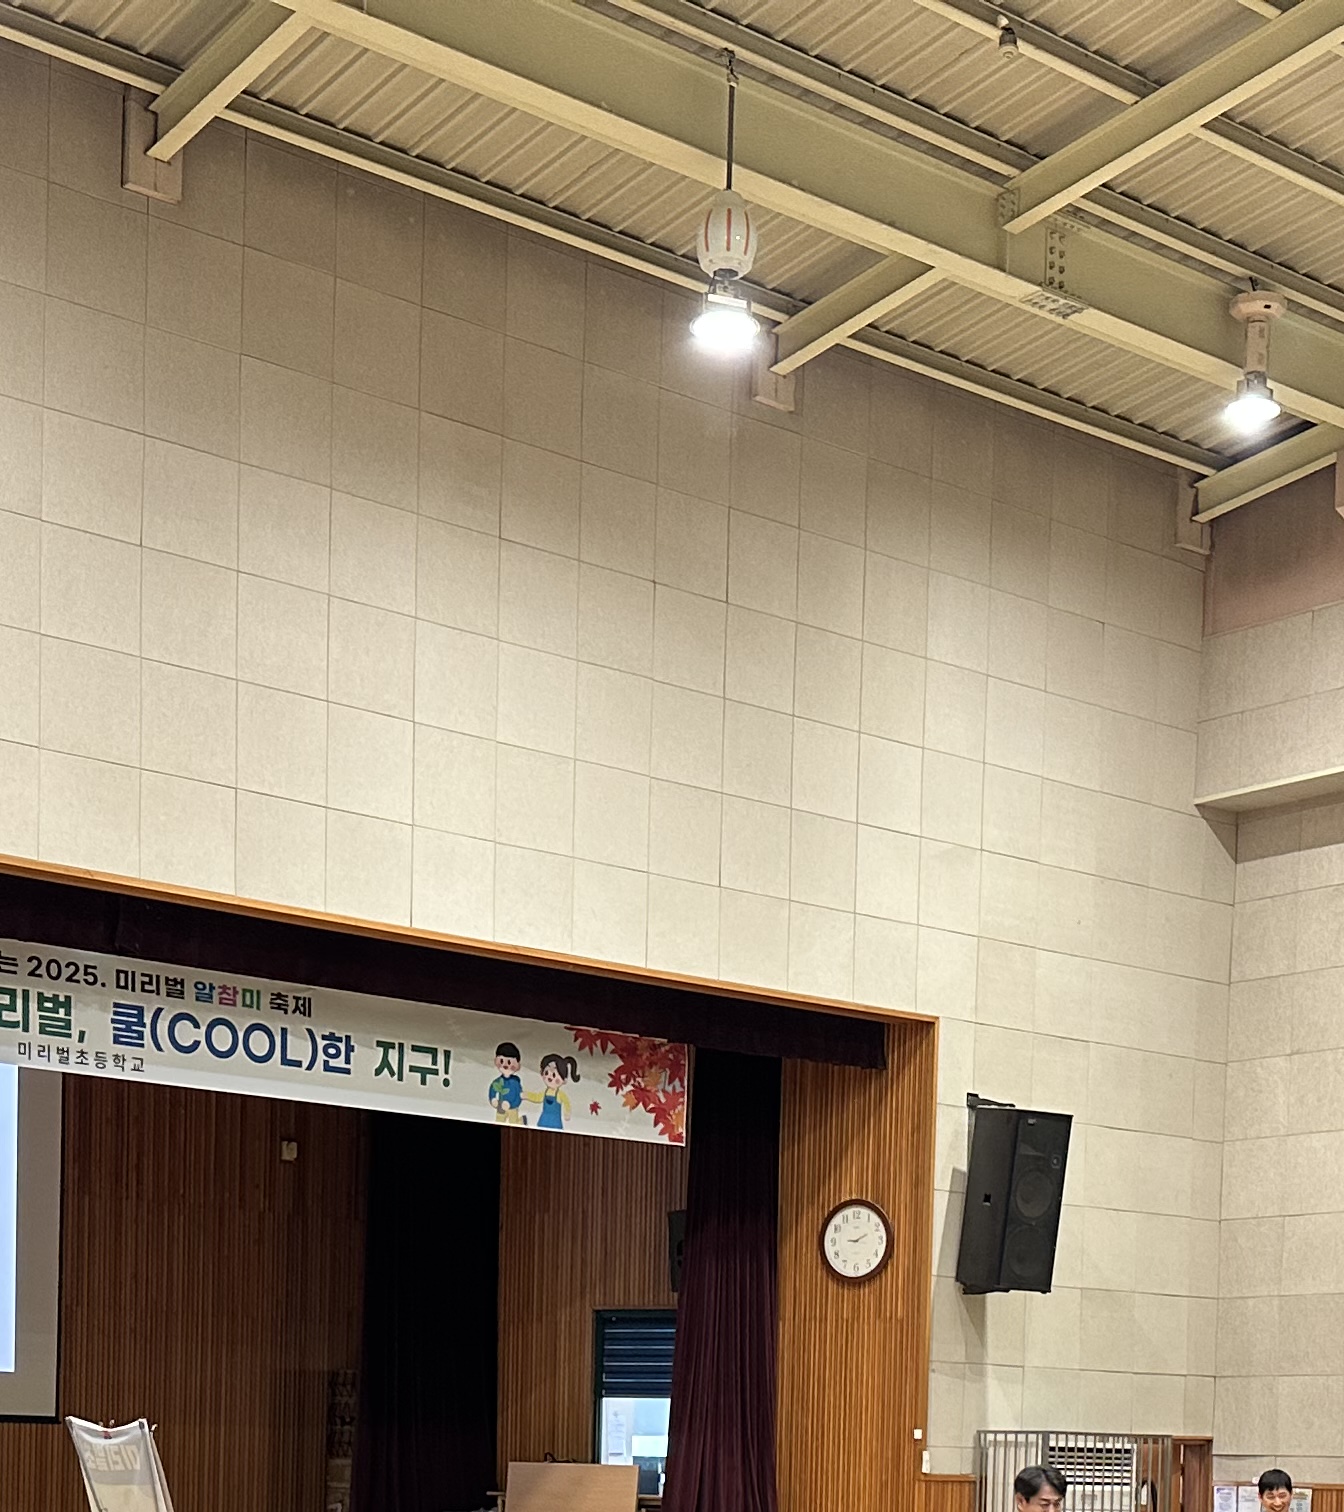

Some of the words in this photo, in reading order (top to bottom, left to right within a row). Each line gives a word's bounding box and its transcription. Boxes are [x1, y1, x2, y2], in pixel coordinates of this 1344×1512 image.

[27, 955, 107, 990] 2025.
[115, 968, 186, 1000] 미리벌
[193, 981, 262, 1011] 알참미
[269, 992, 313, 1019] 축제
[18, 1041, 145, 1073] 미리벌초등학교
[111, 1000, 355, 1076] 쿨(COOL)한
[373, 1039, 453, 1088] 지구!
